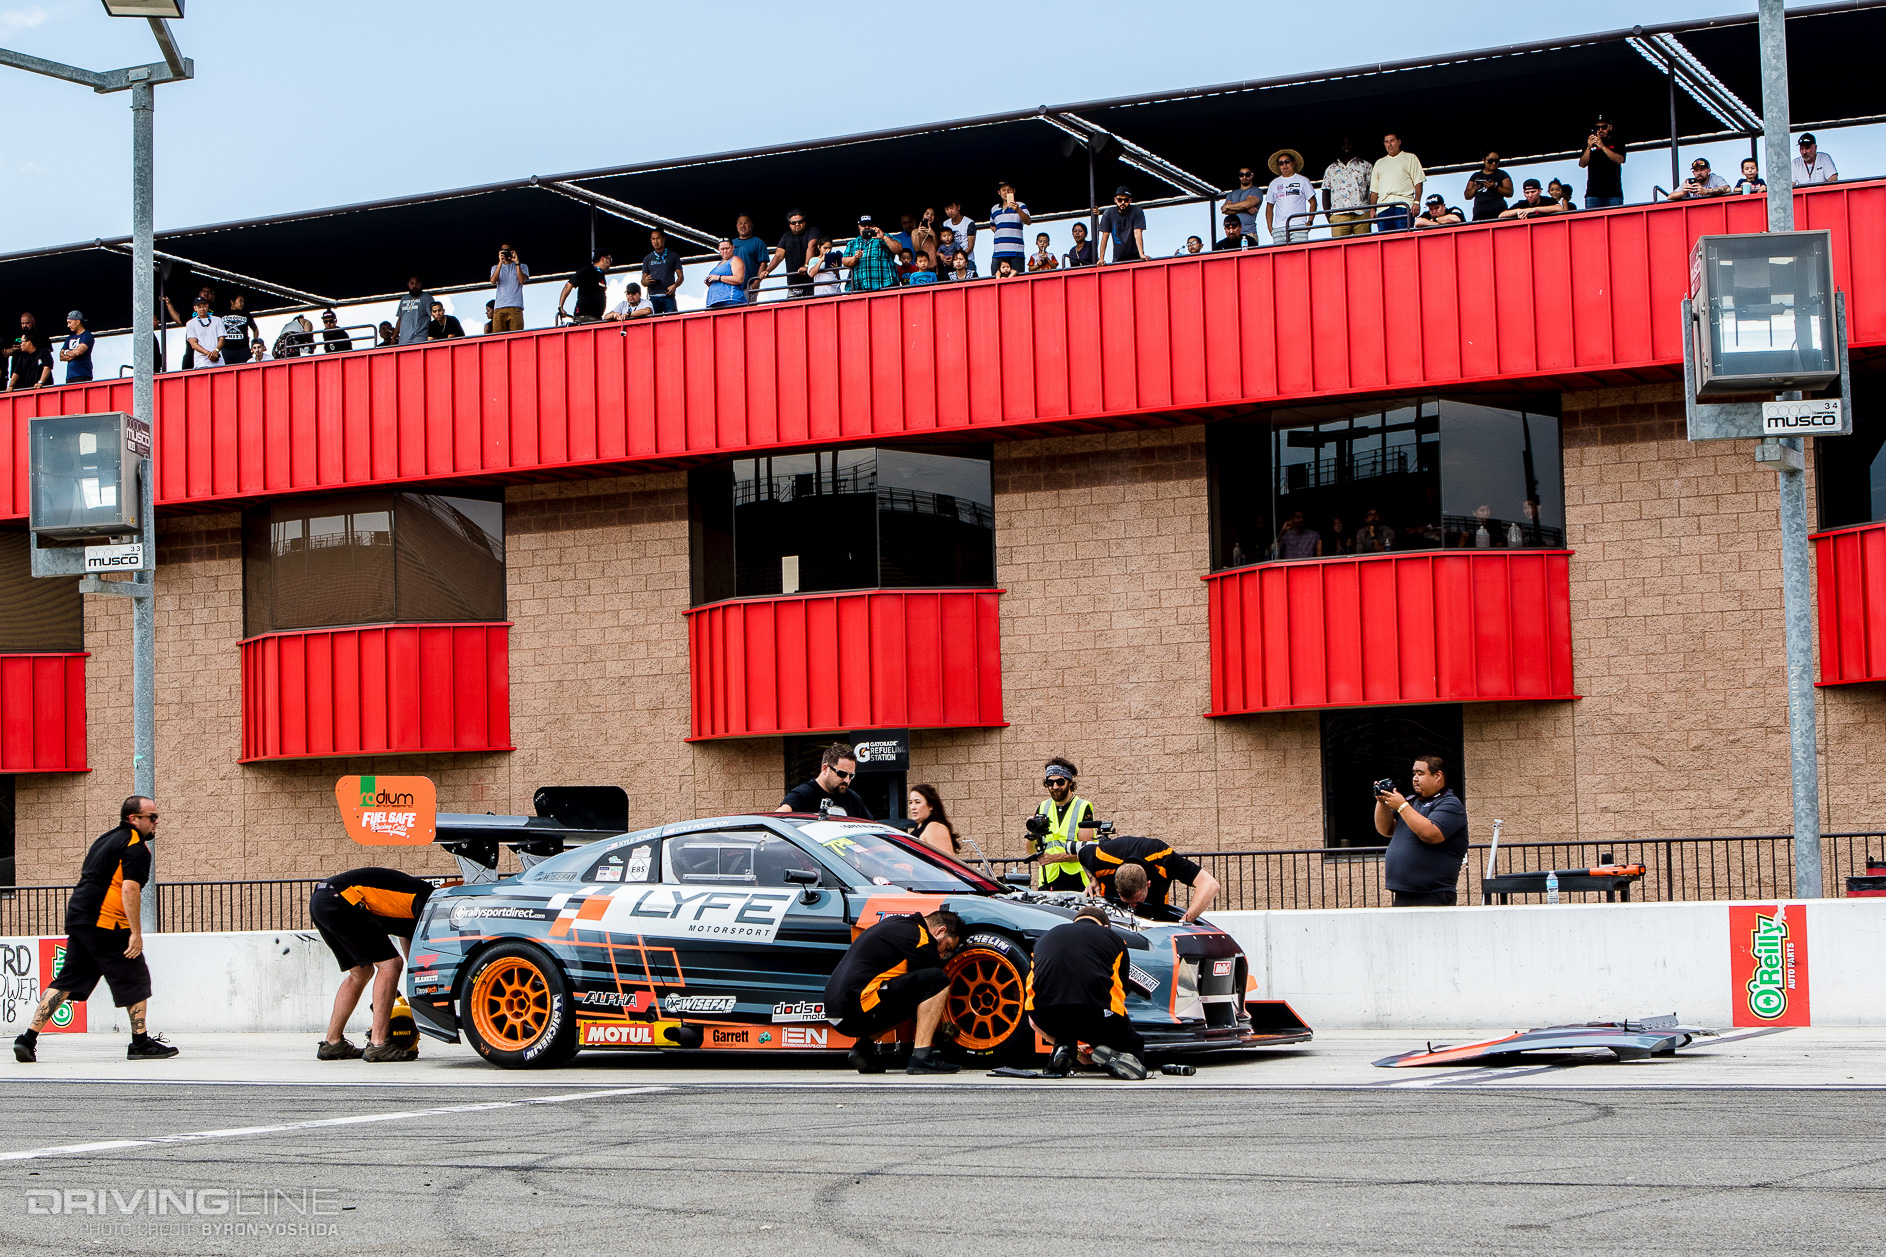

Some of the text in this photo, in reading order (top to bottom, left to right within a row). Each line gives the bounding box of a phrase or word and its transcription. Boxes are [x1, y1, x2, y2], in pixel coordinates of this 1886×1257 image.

[360, 789, 414, 805] radium
[361, 812, 417, 828] FUEL SAFE
[675, 824, 694, 833] COLE
[618, 838, 635, 847] KYLE
[631, 866, 645, 874] E85
[465, 906, 546, 919] rallysportdirect.com
[630, 891, 790, 926] LYFE
[688, 924, 771, 937] MOTORSPORT
[966, 935, 1010, 951] CHELIN
[1754, 921, 1783, 1014] O'Reilly
[1786, 942, 1796, 989] AUTO PARTS
[582, 991, 637, 1007] ALPHA
[681, 998, 737, 1011] WISEFAB
[773, 1001, 825, 1014] dodso
[526, 1010, 563, 1060] MICHELIN
[587, 1026, 652, 1043] MOTUL
[713, 1030, 749, 1043] Garrett
